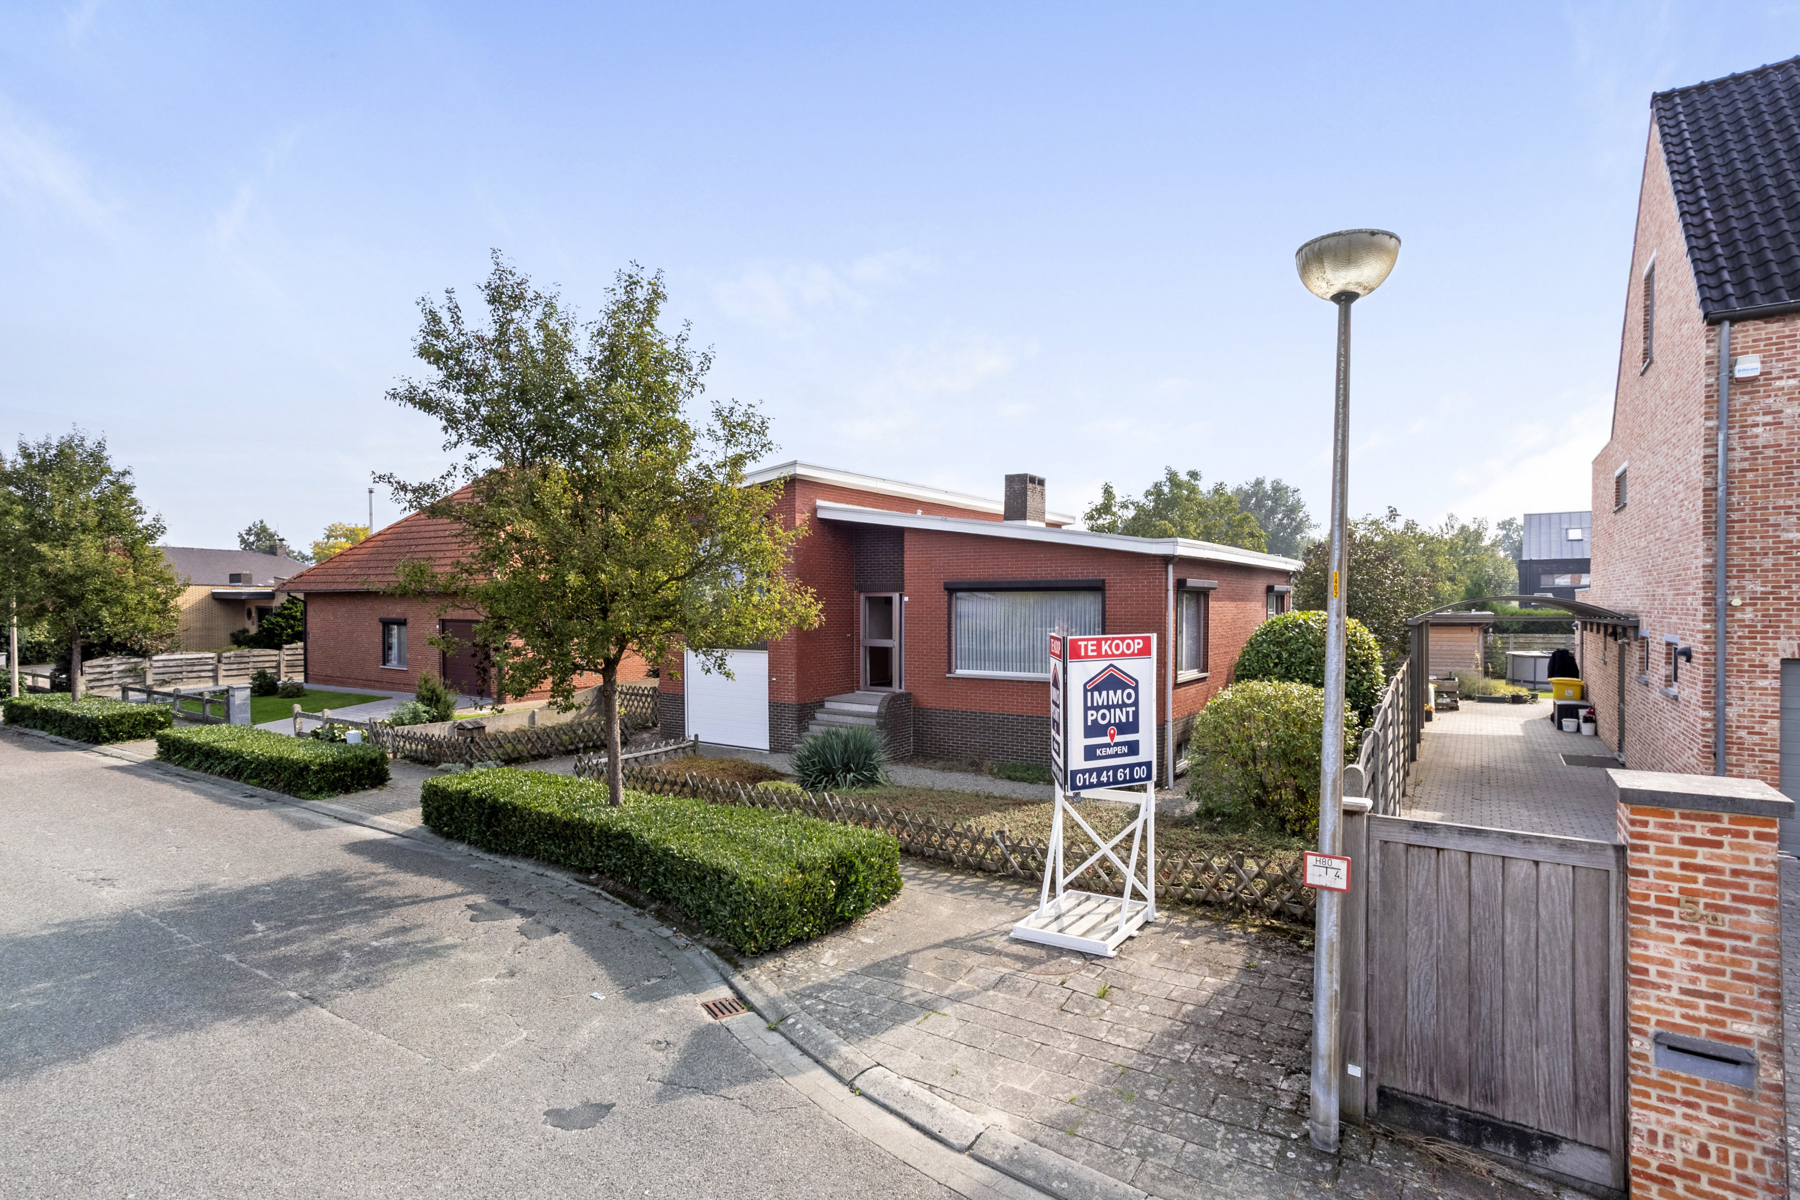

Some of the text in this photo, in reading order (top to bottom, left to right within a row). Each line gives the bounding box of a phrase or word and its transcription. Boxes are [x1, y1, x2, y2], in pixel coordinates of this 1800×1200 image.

[1078, 639, 1143, 656] TE KOOP
[1087, 689, 1135, 706] IMMO
[1087, 707, 1135, 725] POINT
[1096, 745, 1128, 756] KEMPEN
[1076, 772, 1098, 786] 014
[1100, 769, 1113, 783] 41
[1117, 767, 1130, 781] 61
[1134, 765, 1147, 779] 00
[1316, 857, 1333, 866] H80
